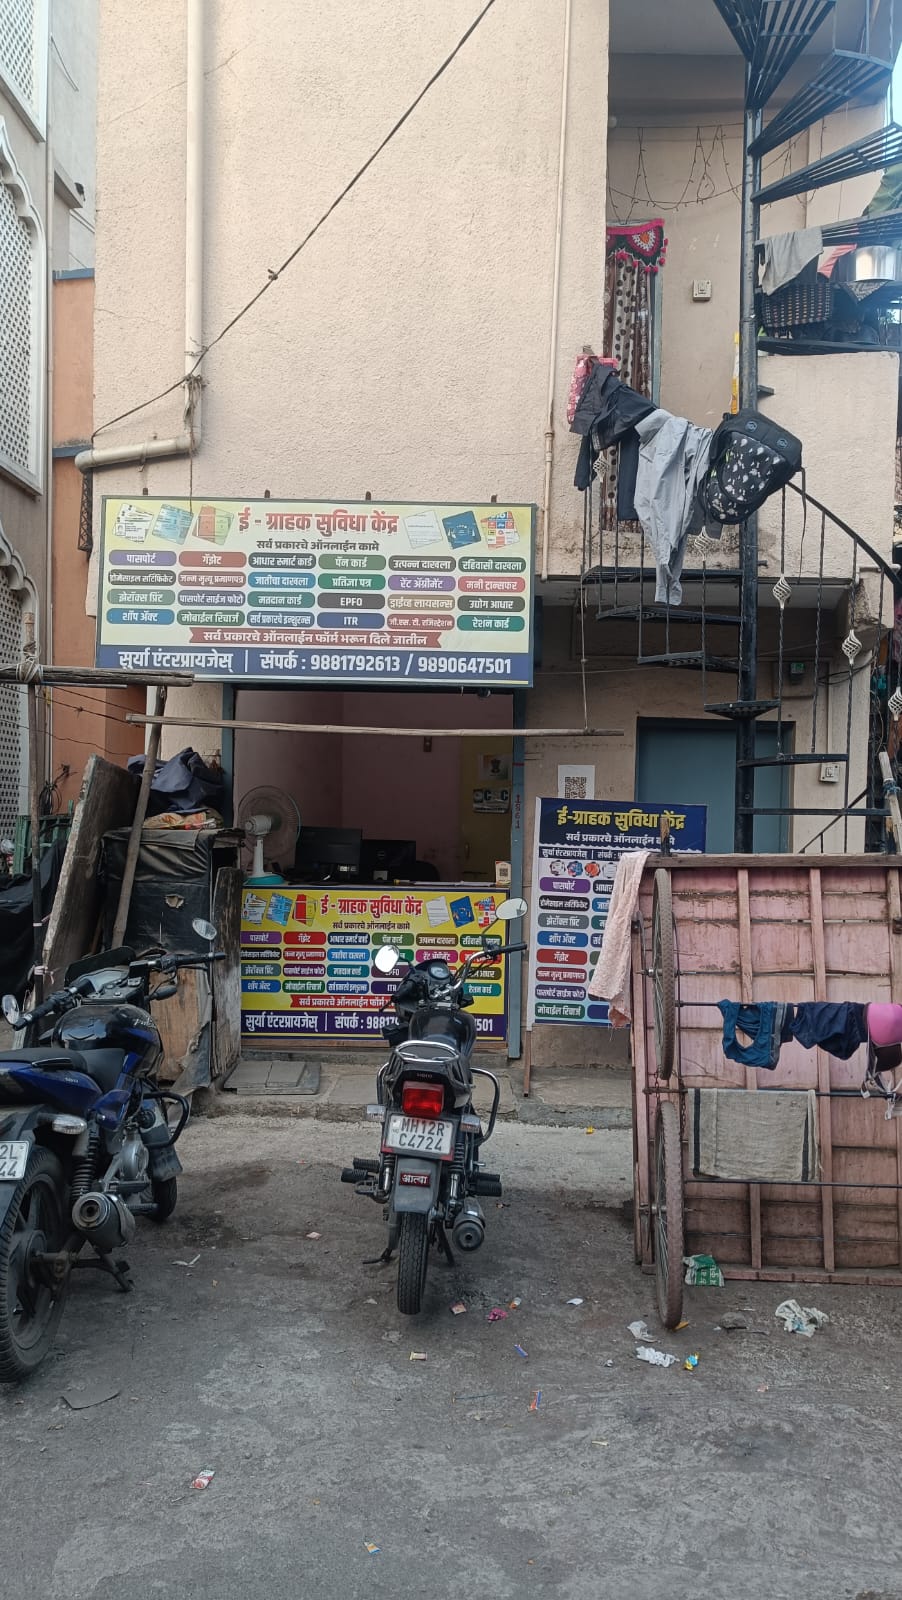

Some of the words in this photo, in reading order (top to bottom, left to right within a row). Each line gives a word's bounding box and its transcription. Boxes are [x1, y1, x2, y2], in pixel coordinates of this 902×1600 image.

[238, 507, 250, 531] ई
[266, 512, 311, 532] ग्राहक
[316, 509, 368, 537] सुविधा
[371, 510, 399, 535] केंद्र
[257, 539, 272, 549] सर्व
[275, 538, 308, 550] प्रकारचे
[310, 540, 357, 552] ऑनलाईन
[359, 541, 379, 552] कामे
[126, 553, 156, 563] पासपोर्ट
[202, 553, 222, 565] गॅझेट
[252, 556, 275, 566] आधार
[277, 556, 296, 566] स्मार्ट
[297, 556, 312, 567] कार्ड
[335, 557, 349, 568] पॅन
[350, 557, 368, 568] कार्ड
[393, 560, 420, 569] उत्पन्न
[422, 560, 451, 570] दाखला
[462, 559, 493, 571] रहिवासी
[495, 561, 522, 571] दाखला
[180, 574, 197, 582] जन्म
[198, 574, 213, 585] मृत्यू
[214, 575, 244, 584] प्रमाणपत्र
[254, 576, 281, 586] जातीचा
[282, 577, 308, 586] दाखला
[332, 575, 357, 587] प्रतिज्ञा
[359, 578, 372, 587] पत्र
[400, 577, 413, 588] रेंट
[466, 579, 483, 590] मनी
[485, 580, 517, 591] ट्रान्सफर
[118, 590, 147, 602] झेरॉक्स
[149, 591, 164, 602] प्रिंट
[179, 593, 205, 604] पासपोर्ट
[227, 593, 244, 604] फोटो
[257, 595, 285, 605] मतदान
[287, 594, 302, 605] कार्ड
[340, 597, 362, 606] EPFO
[414, 599, 453, 609] लायसन्स
[469, 598, 488, 609] उद्योग
[490, 600, 514, 609] आधार
[122, 610, 138, 622] शॉप
[181, 611, 211, 624] मोबाईल
[214, 611, 239, 624] रिचार्ज
[250, 613, 261, 624] सर्व
[262, 613, 282, 624] प्रकारचे
[344, 616, 358, 625] ITR
[472, 617, 492, 628] रेशन
[494, 617, 510, 628] कार्ड
[203, 630, 220, 641] सर्व
[223, 630, 260, 642] प्रकारचे
[263, 630, 312, 644] ऑनलाईन
[315, 632, 339, 644] फॉर्म
[341, 634, 367, 645] भरून
[369, 633, 391, 645] दिले
[392, 634, 427, 646] जातील
[260, 650, 299, 670] संपर्क
[310, 654, 400, 671] 9881792613
[418, 657, 511, 674] 9890647501
[557, 805, 612, 826] ई-ग्राहक
[614, 808, 659, 831] सुविधा
[566, 832, 580, 842] सर्व
[582, 831, 612, 843] प्रकारचे
[613, 834, 654, 846] ऑनलाईन
[552, 880, 576, 890] पासपोर्ट
[320, 894, 329, 914] ई
[337, 897, 368, 914] ग्राहक
[369, 895, 403, 918] सुविधा
[404, 896, 423, 916] केंद्र
[333, 921, 343, 929] सर्व
[344, 921, 365, 930] प्रकारचे
[396, 921, 410, 930] कामे
[299, 998, 310, 1006] सर्व
[311, 998, 335, 1006] प्रकारचे
[336, 998, 368, 1008] ऑनलाईन
[246, 1011, 265, 1031] सुर्या
[334, 1012, 359, 1029] संपर्क
[401, 1118, 444, 1136] MH12R
[399, 1134, 442, 1151] C4724
